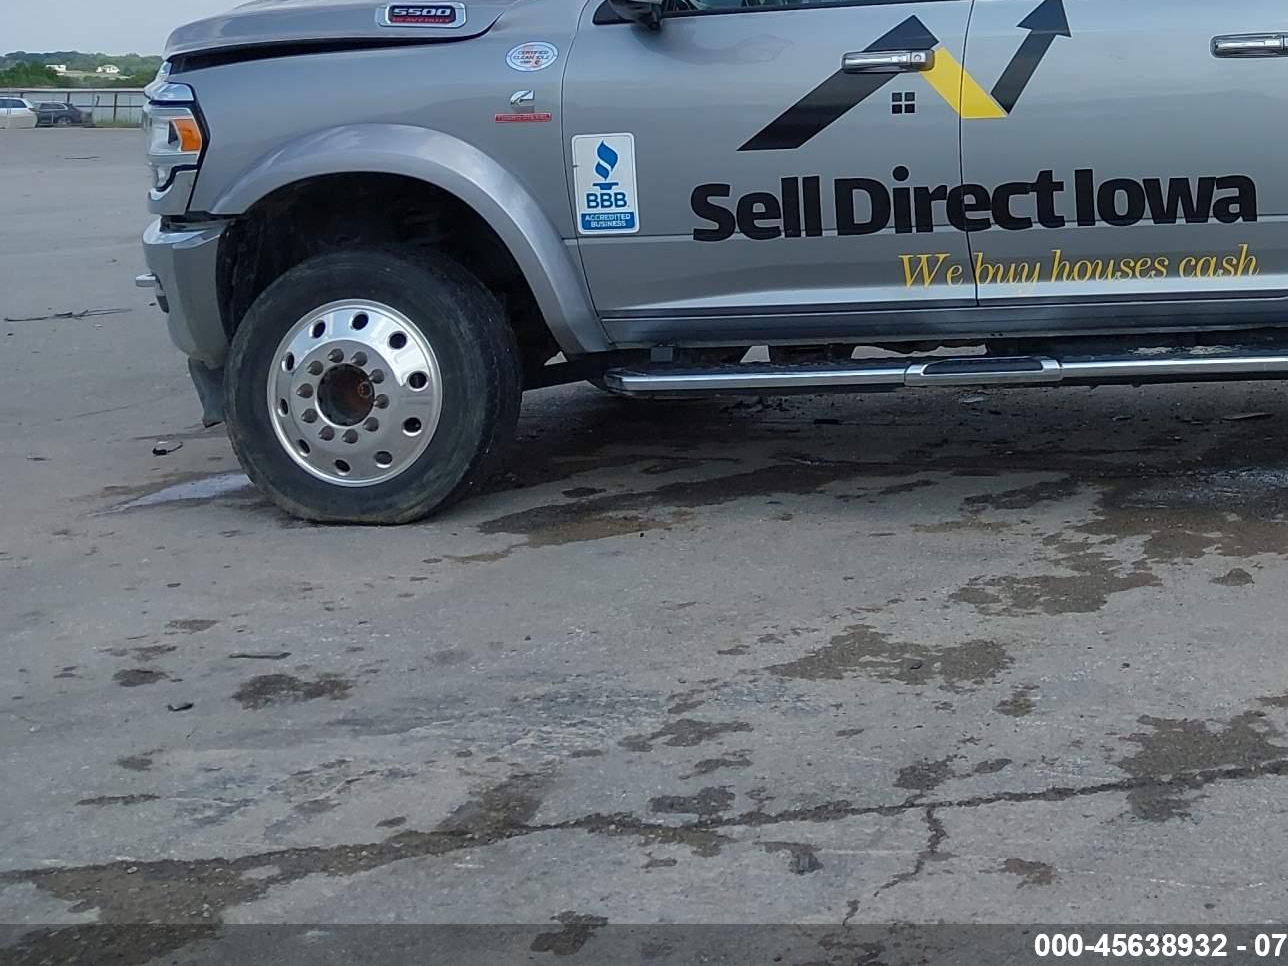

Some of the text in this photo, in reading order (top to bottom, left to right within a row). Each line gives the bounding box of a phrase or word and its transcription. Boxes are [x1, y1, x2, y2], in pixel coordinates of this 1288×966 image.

[392, 8, 451, 16] 5500
[586, 192, 628, 208] BBB
[690, 165, 1258, 242] Sell Direct Iowa
[898, 243, 1260, 295] We buy houses cash
